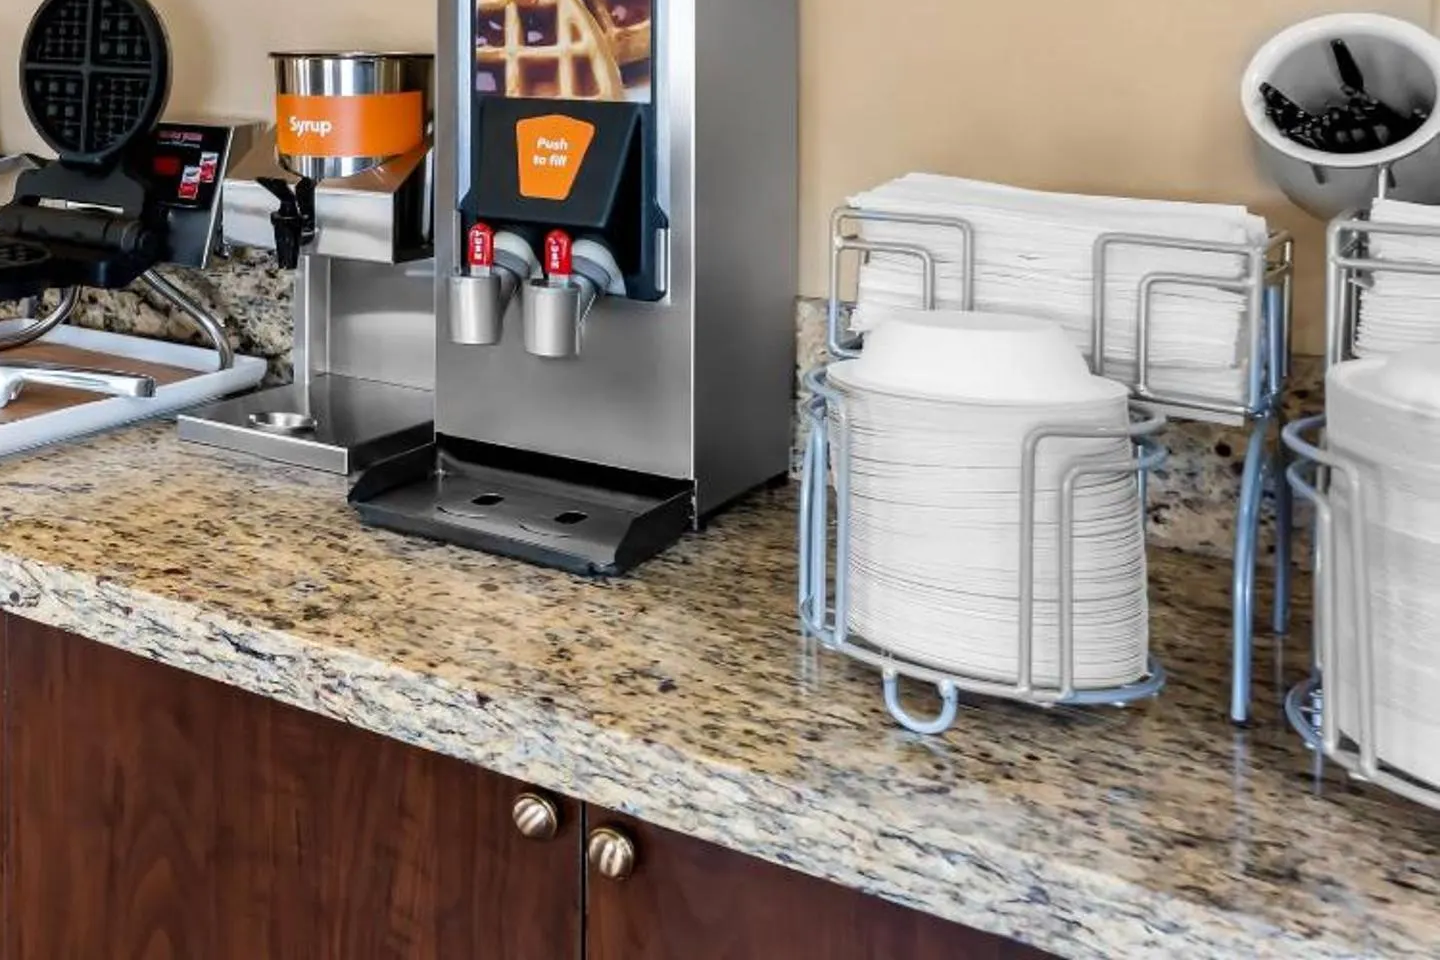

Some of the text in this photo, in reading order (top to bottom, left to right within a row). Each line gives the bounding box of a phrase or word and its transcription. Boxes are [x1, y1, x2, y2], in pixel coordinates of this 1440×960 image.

[289, 116, 332, 138] Syrup
[536, 136, 568, 150] Push
[533, 153, 568, 167] to fill
